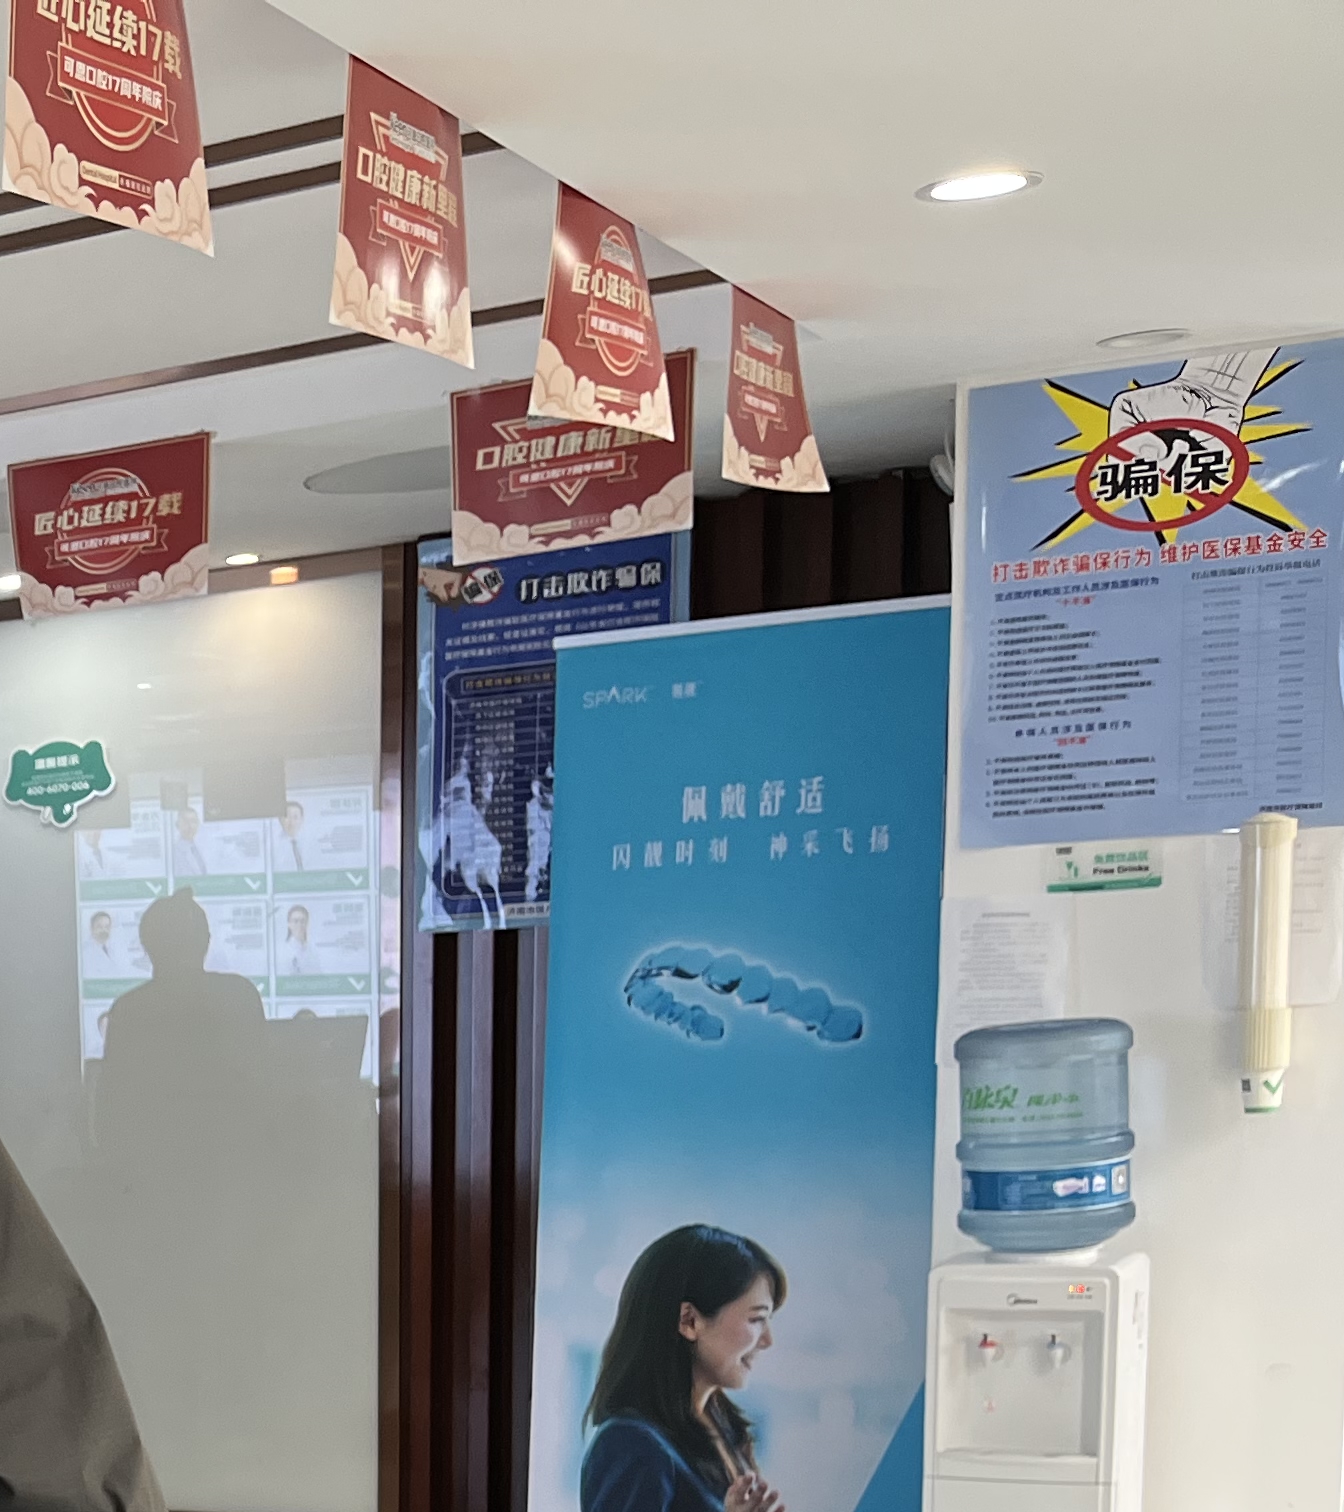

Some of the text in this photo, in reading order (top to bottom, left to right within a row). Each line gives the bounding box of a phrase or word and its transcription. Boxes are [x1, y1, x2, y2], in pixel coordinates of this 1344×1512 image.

[475, 426, 662, 471] 口腔健康新里
[1096, 450, 1230, 502] 骗保
[34, 492, 183, 535] 匠心延续17载
[992, 527, 1328, 584] 打击欺诈骗保行为 维护医保基金安全
[520, 561, 662, 602] 打击欺诈骗保
[582, 686, 648, 709] SPARK
[682, 776, 824, 823] 佩戴舒适
